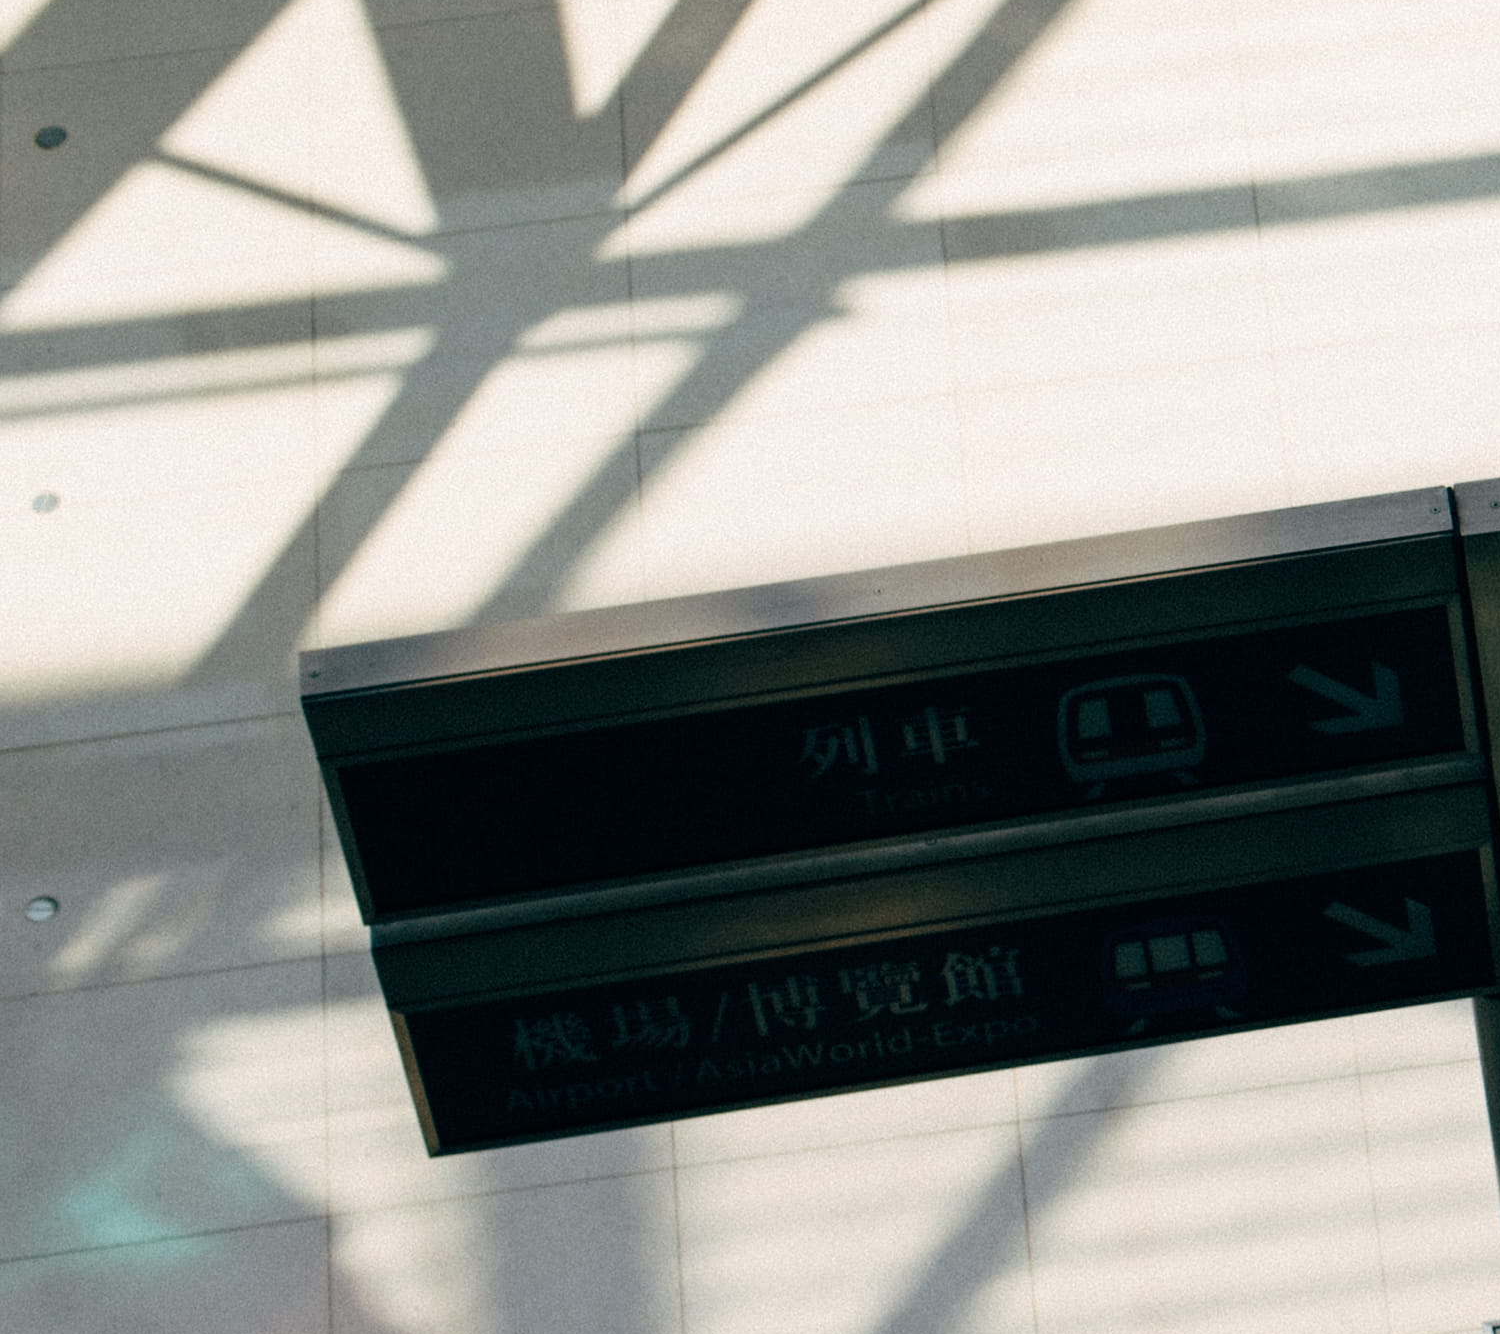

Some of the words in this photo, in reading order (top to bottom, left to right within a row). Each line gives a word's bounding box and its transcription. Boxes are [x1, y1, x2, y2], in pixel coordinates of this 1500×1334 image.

[800, 707, 979, 778] 列車
[505, 1070, 658, 1116] Airport
[695, 1013, 1040, 1086] AsiaWorld-Expo
